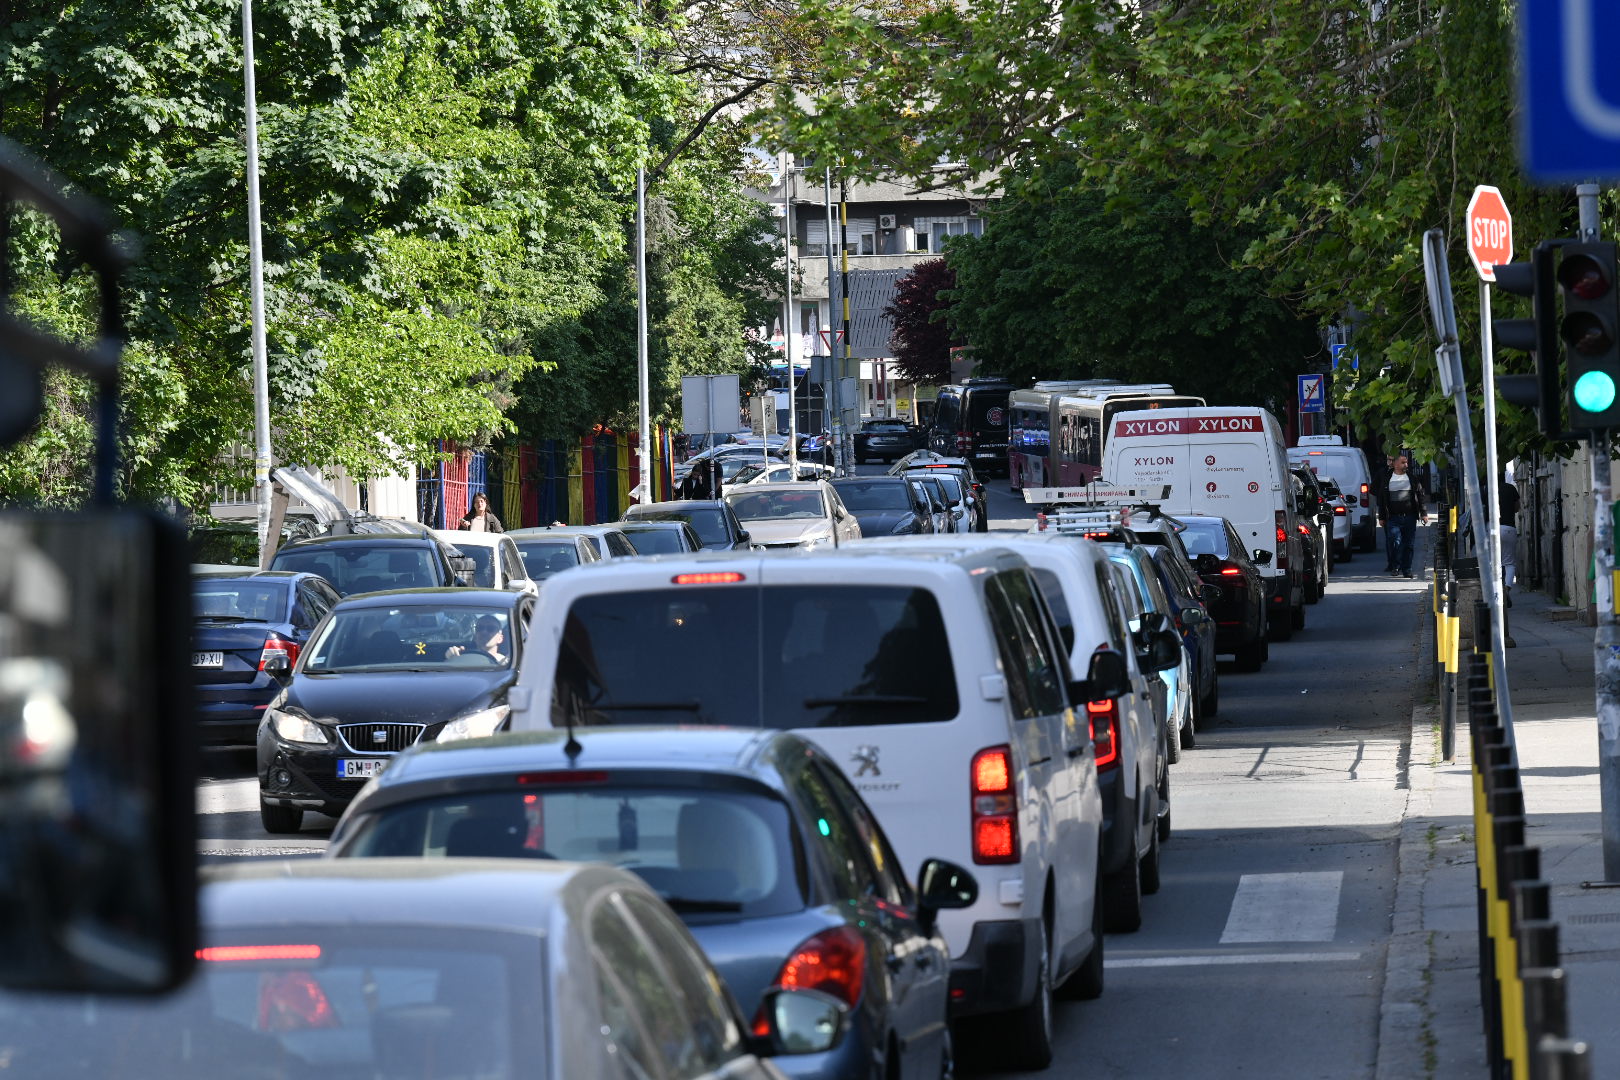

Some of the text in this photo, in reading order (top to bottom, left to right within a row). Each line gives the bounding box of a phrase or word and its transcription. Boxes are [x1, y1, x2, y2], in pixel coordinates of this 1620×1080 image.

[1474, 216, 1507, 249] STOP
[1125, 418, 1253, 434] XYLON XYLON
[1134, 456, 1174, 466] XYLON
[347, 761, 363, 775] GM
